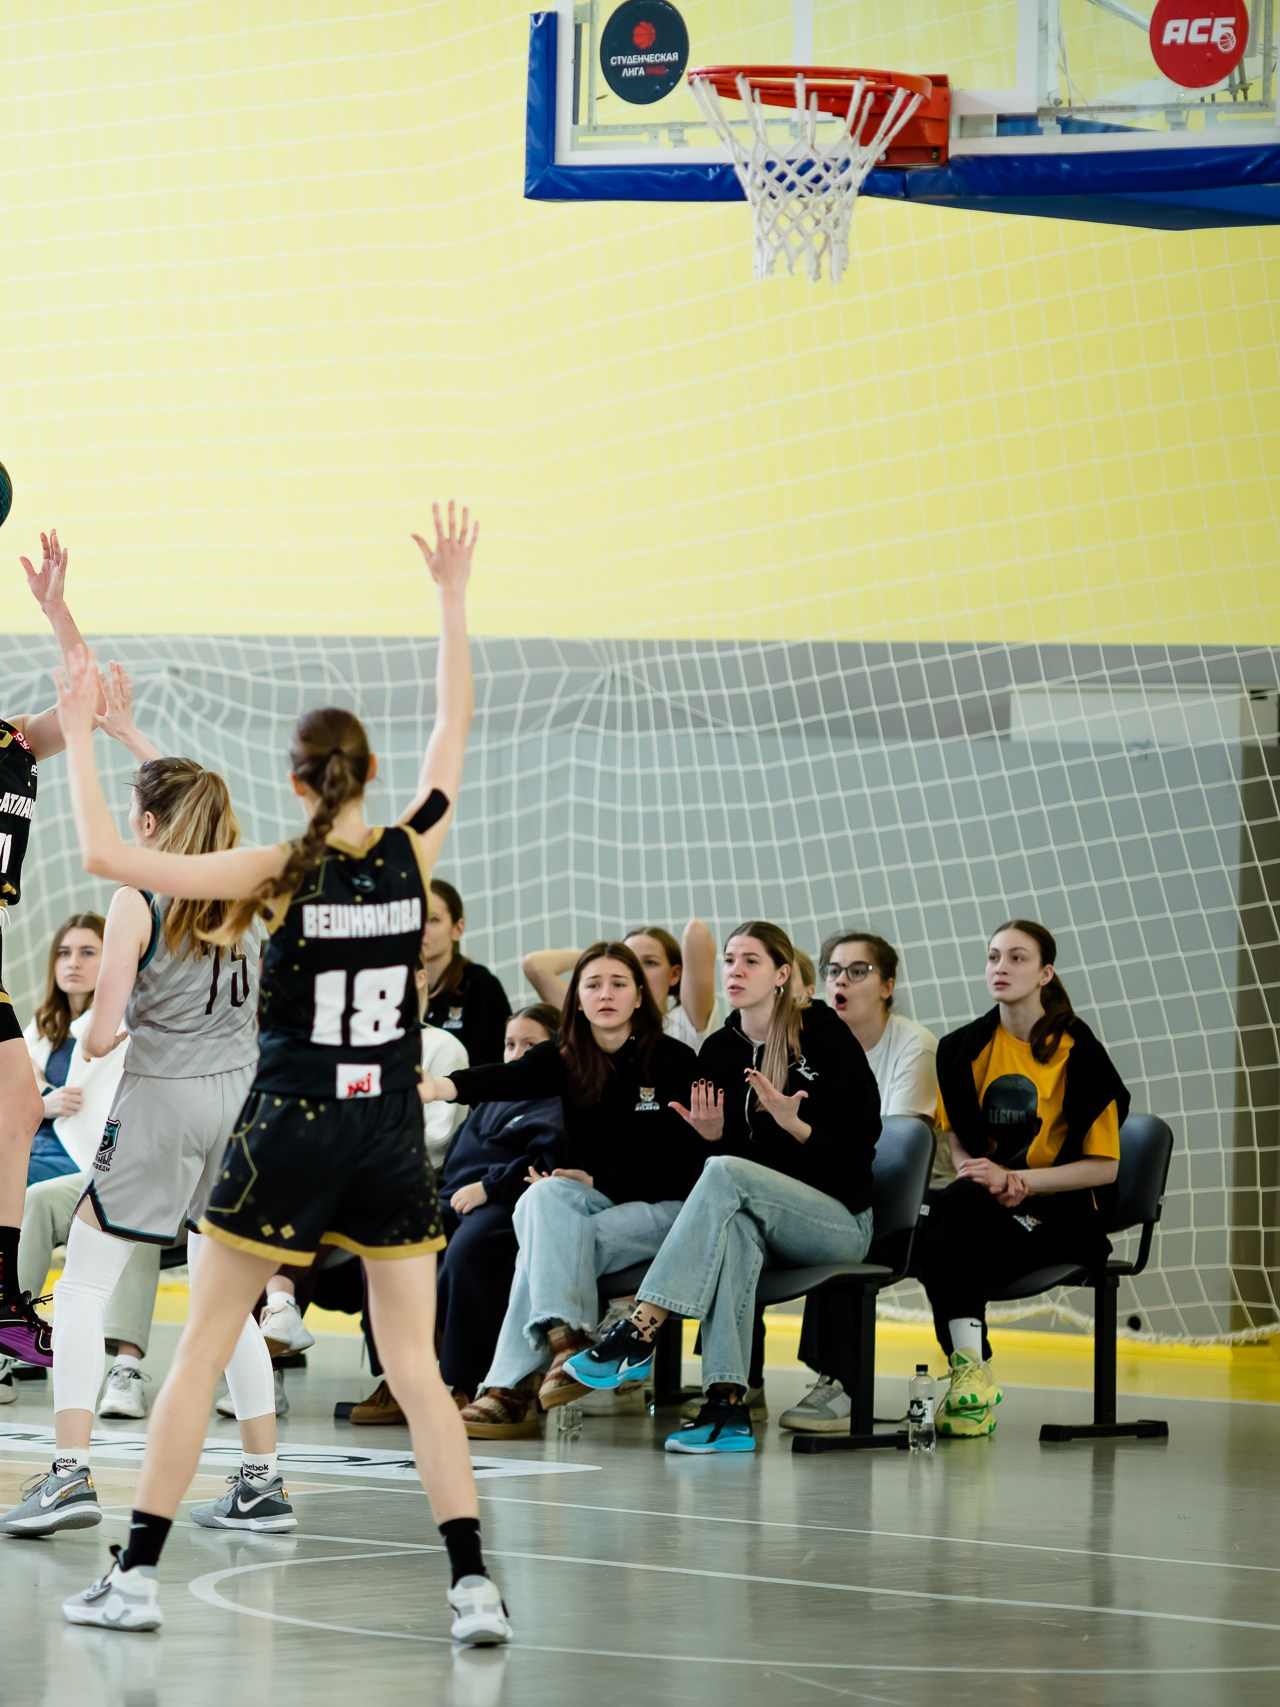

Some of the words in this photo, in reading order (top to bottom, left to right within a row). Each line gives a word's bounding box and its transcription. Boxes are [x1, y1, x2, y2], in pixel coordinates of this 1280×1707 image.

[1162, 17, 1237, 47] АСБ
[610, 52, 679, 65] СТУДЕНЧЕСКАЯ
[621, 67, 645, 77] ЛИГА
[310, 964, 409, 1047] 18
